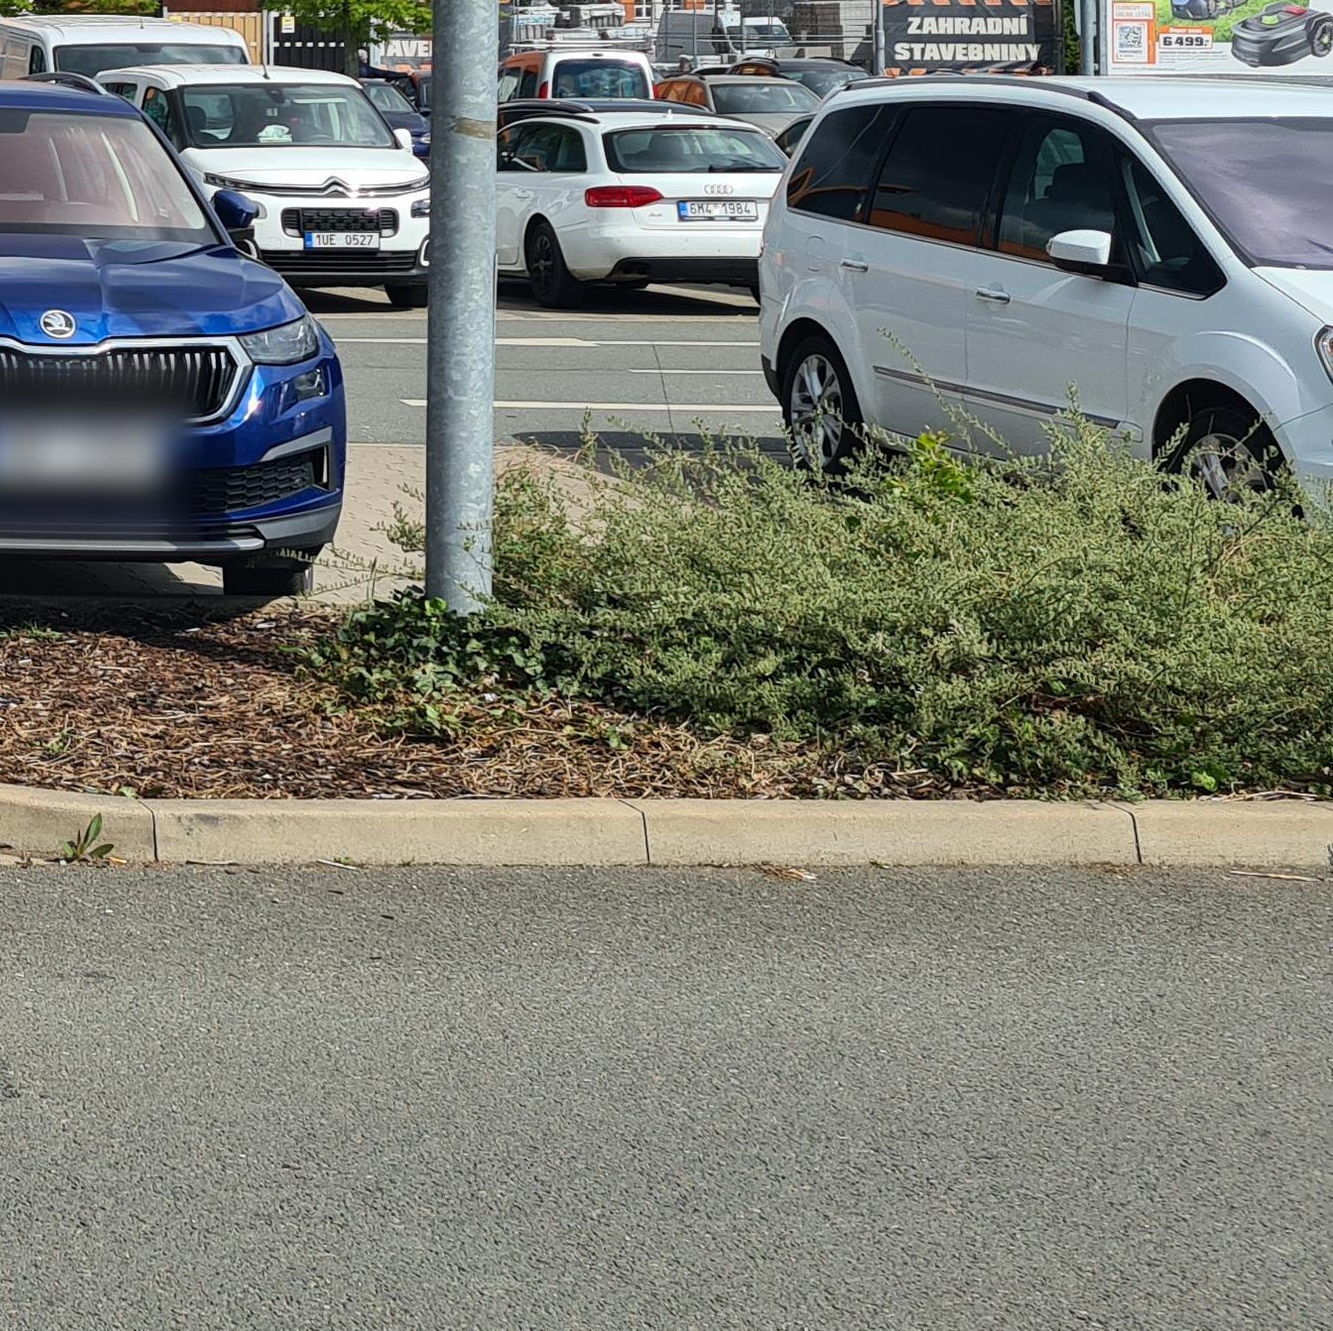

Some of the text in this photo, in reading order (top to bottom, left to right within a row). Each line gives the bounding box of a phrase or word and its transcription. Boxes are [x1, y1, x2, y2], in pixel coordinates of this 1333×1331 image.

[906, 13, 1029, 35] ZAHRADNÍ
[893, 42, 1042, 62] STAVEBNINY
[721, 203, 751, 215] 1984
[316, 234, 374, 246] 1UE 0527
